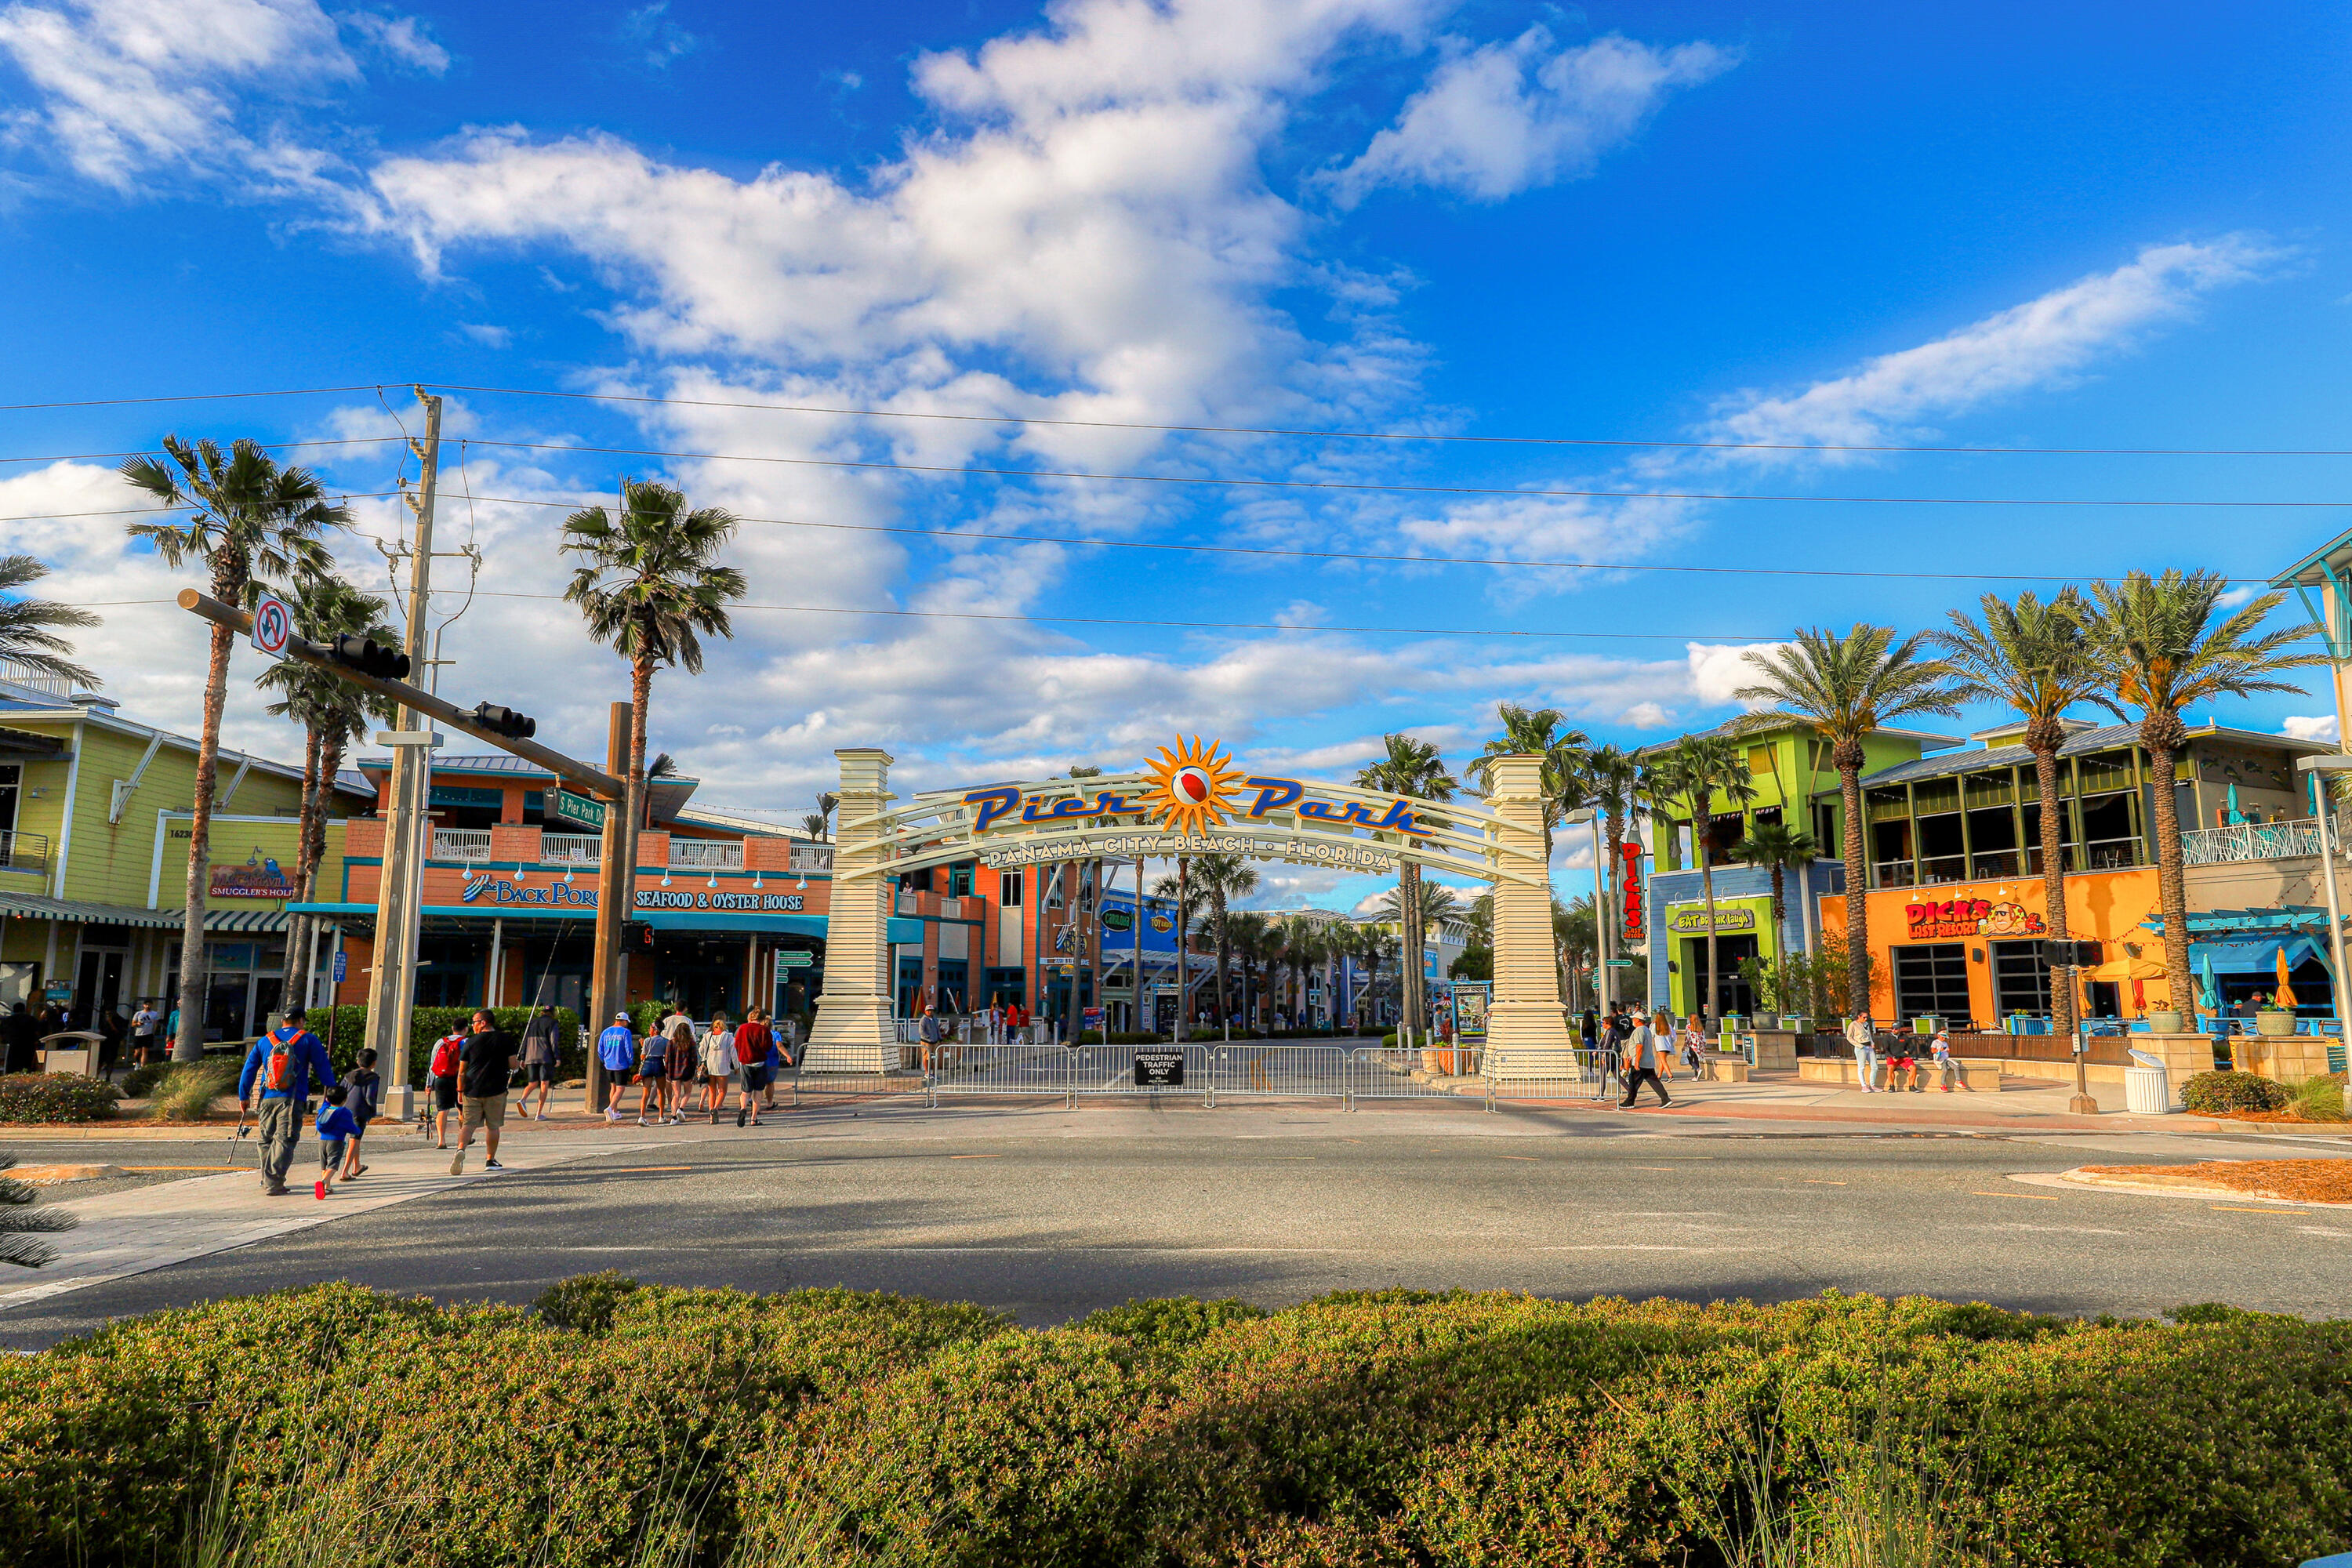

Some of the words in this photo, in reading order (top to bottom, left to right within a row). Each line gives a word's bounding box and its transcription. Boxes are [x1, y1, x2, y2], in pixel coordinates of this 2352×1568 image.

[560, 796, 565, 811] S
[567, 798, 579, 815] Pier
[581, 804, 594, 821] Park
[596, 808, 603, 823] Dr
[960, 786, 1148, 835] Pier
[1240, 775, 1436, 837] Park
[989, 839, 1093, 867] PANAMA
[1103, 835, 1162, 854] CITY
[1173, 834, 1255, 854] BEACH
[1285, 840, 1392, 870] FLORIDA
[212, 887, 267, 896] SMUGGLER'S
[481, 881, 497, 891] the
[495, 880, 549, 903] BACK
[1621, 842, 1642, 927] DICK'S
[635, 891, 694, 908] SEAFOOD
[697, 892, 710, 909] &
[712, 892, 760, 910] OYSTER
[762, 895, 804, 910] HOUSE
[1905, 898, 1993, 926] DICK'S
[1679, 914, 1700, 928] EAT
[1726, 909, 1750, 928] laugh
[1907, 924, 1937, 939] LAST
[1937, 920, 1979, 937] RESORT
[644, 927, 652, 944] 6
